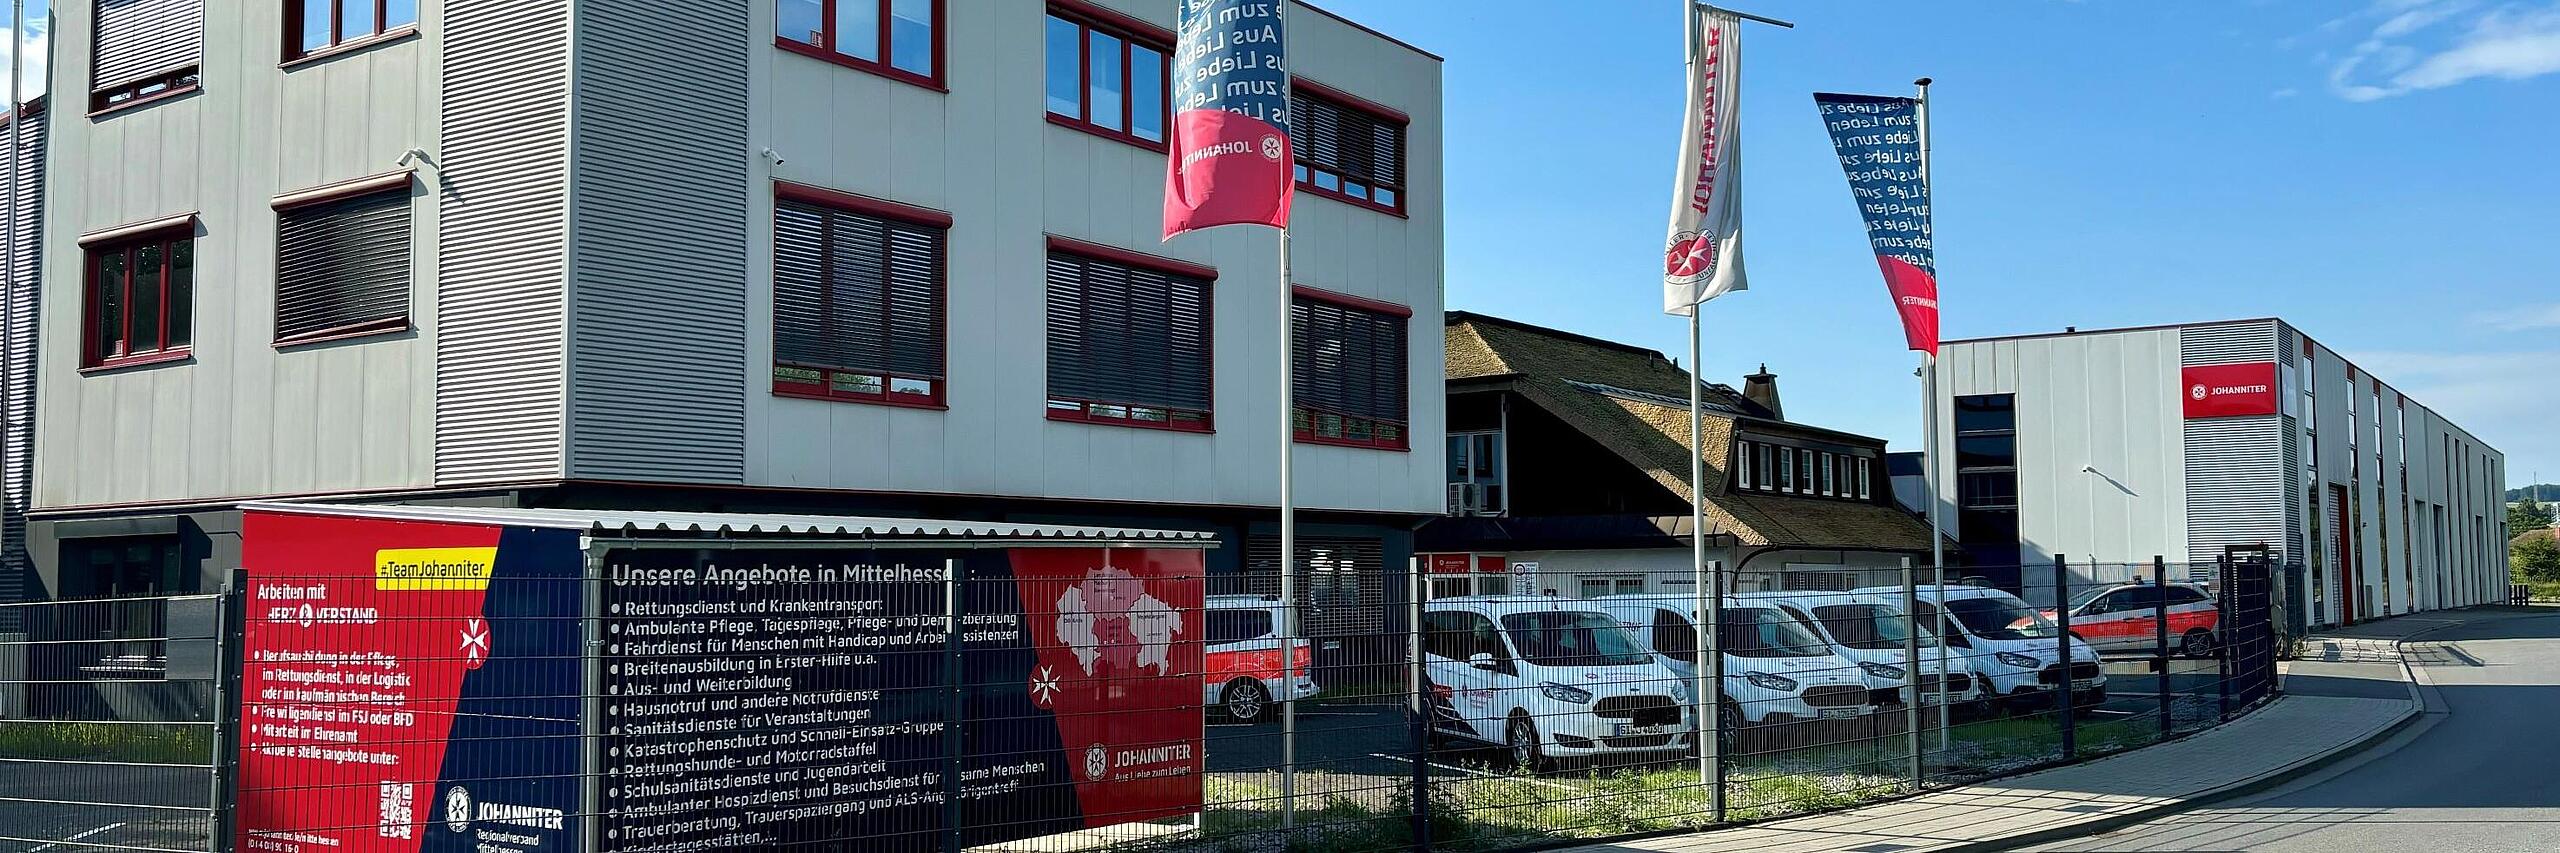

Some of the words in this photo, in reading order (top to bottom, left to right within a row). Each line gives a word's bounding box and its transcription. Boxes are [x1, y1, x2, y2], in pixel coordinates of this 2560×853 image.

[1691, 26, 1721, 217] JOHANNITER
[2210, 385, 2267, 395] JOHANNITER
[381, 559, 485, 577] #TeamJohanniter
[612, 564, 696, 586] Unsere
[703, 563, 811, 591] Angebote
[818, 564, 836, 583] in
[258, 584, 304, 600] Arbeiten
[307, 583, 326, 600] mit
[625, 600, 736, 618] Rettungsdienst
[740, 599, 766, 613] und
[769, 599, 883, 614] Krankentransport
[624, 620, 705, 636] Ambulante
[709, 619, 758, 636] Pflege,
[762, 617, 844, 634] Tagespflege,
[896, 614, 918, 627] und
[624, 641, 702, 656] Fahrdienst
[707, 639, 727, 653] für
[731, 636, 798, 653] Menschen
[803, 635, 824, 649] mit
[828, 633, 886, 650] Handicap
[889, 631, 912, 645] und
[263, 650, 338, 667] Berufsausbidung
[624, 657, 755, 676] Breitenausbildung
[759, 656, 772, 670] in
[776, 652, 850, 669] Erster-Hilfe
[854, 652, 878, 665] u.a.
[262, 667, 274, 681] im
[275, 669, 344, 686] Rettungsdienst,
[345, 671, 354, 684] in
[356, 671, 372, 685] der
[624, 682, 657, 696] Aus-
[664, 679, 691, 694] und
[696, 674, 792, 692] Weiterbildung
[262, 686, 283, 700] oder
[624, 699, 706, 717] Hausnotruf
[711, 695, 737, 711] und
[741, 692, 788, 709] andere
[793, 689, 880, 706] Notrufdienste
[261, 705, 336, 722] Frewiligendienst
[352, 710, 369, 723] FSJ
[370, 711, 393, 725] oder
[393, 712, 414, 726] BFD
[624, 718, 737, 737] Sanitätsdienste
[741, 714, 762, 729] für
[765, 707, 872, 726] Veranstaltungen
[314, 726, 358, 743] Ehrenamt
[625, 733, 767, 758] Katastrophenschutz
[771, 729, 796, 745] und
[260, 741, 295, 757] Aktuele
[370, 751, 399, 765] unter:
[625, 756, 742, 777] Rettungshunde-
[746, 750, 771, 767] und
[775, 742, 876, 765] Motorradstaffel
[1114, 743, 1191, 768] JOHANNITER
[623, 798, 711, 819] Ambulanter
[714, 786, 801, 809] Hospizdienst
[804, 783, 829, 799] und
[833, 773, 919, 796] Besuchsdienst
[923, 771, 940, 787] für
[992, 760, 1045, 777] Menschen
[624, 771, 771, 799] Schulsanitätsdienste
[775, 768, 799, 783] und
[803, 760, 886, 782] Jugendarbeit
[477, 801, 563, 830] JOHANNITER
[622, 815, 741, 840] Trauerberatung,
[745, 799, 865, 825] Trauerspaziergang
[869, 794, 892, 810] und
